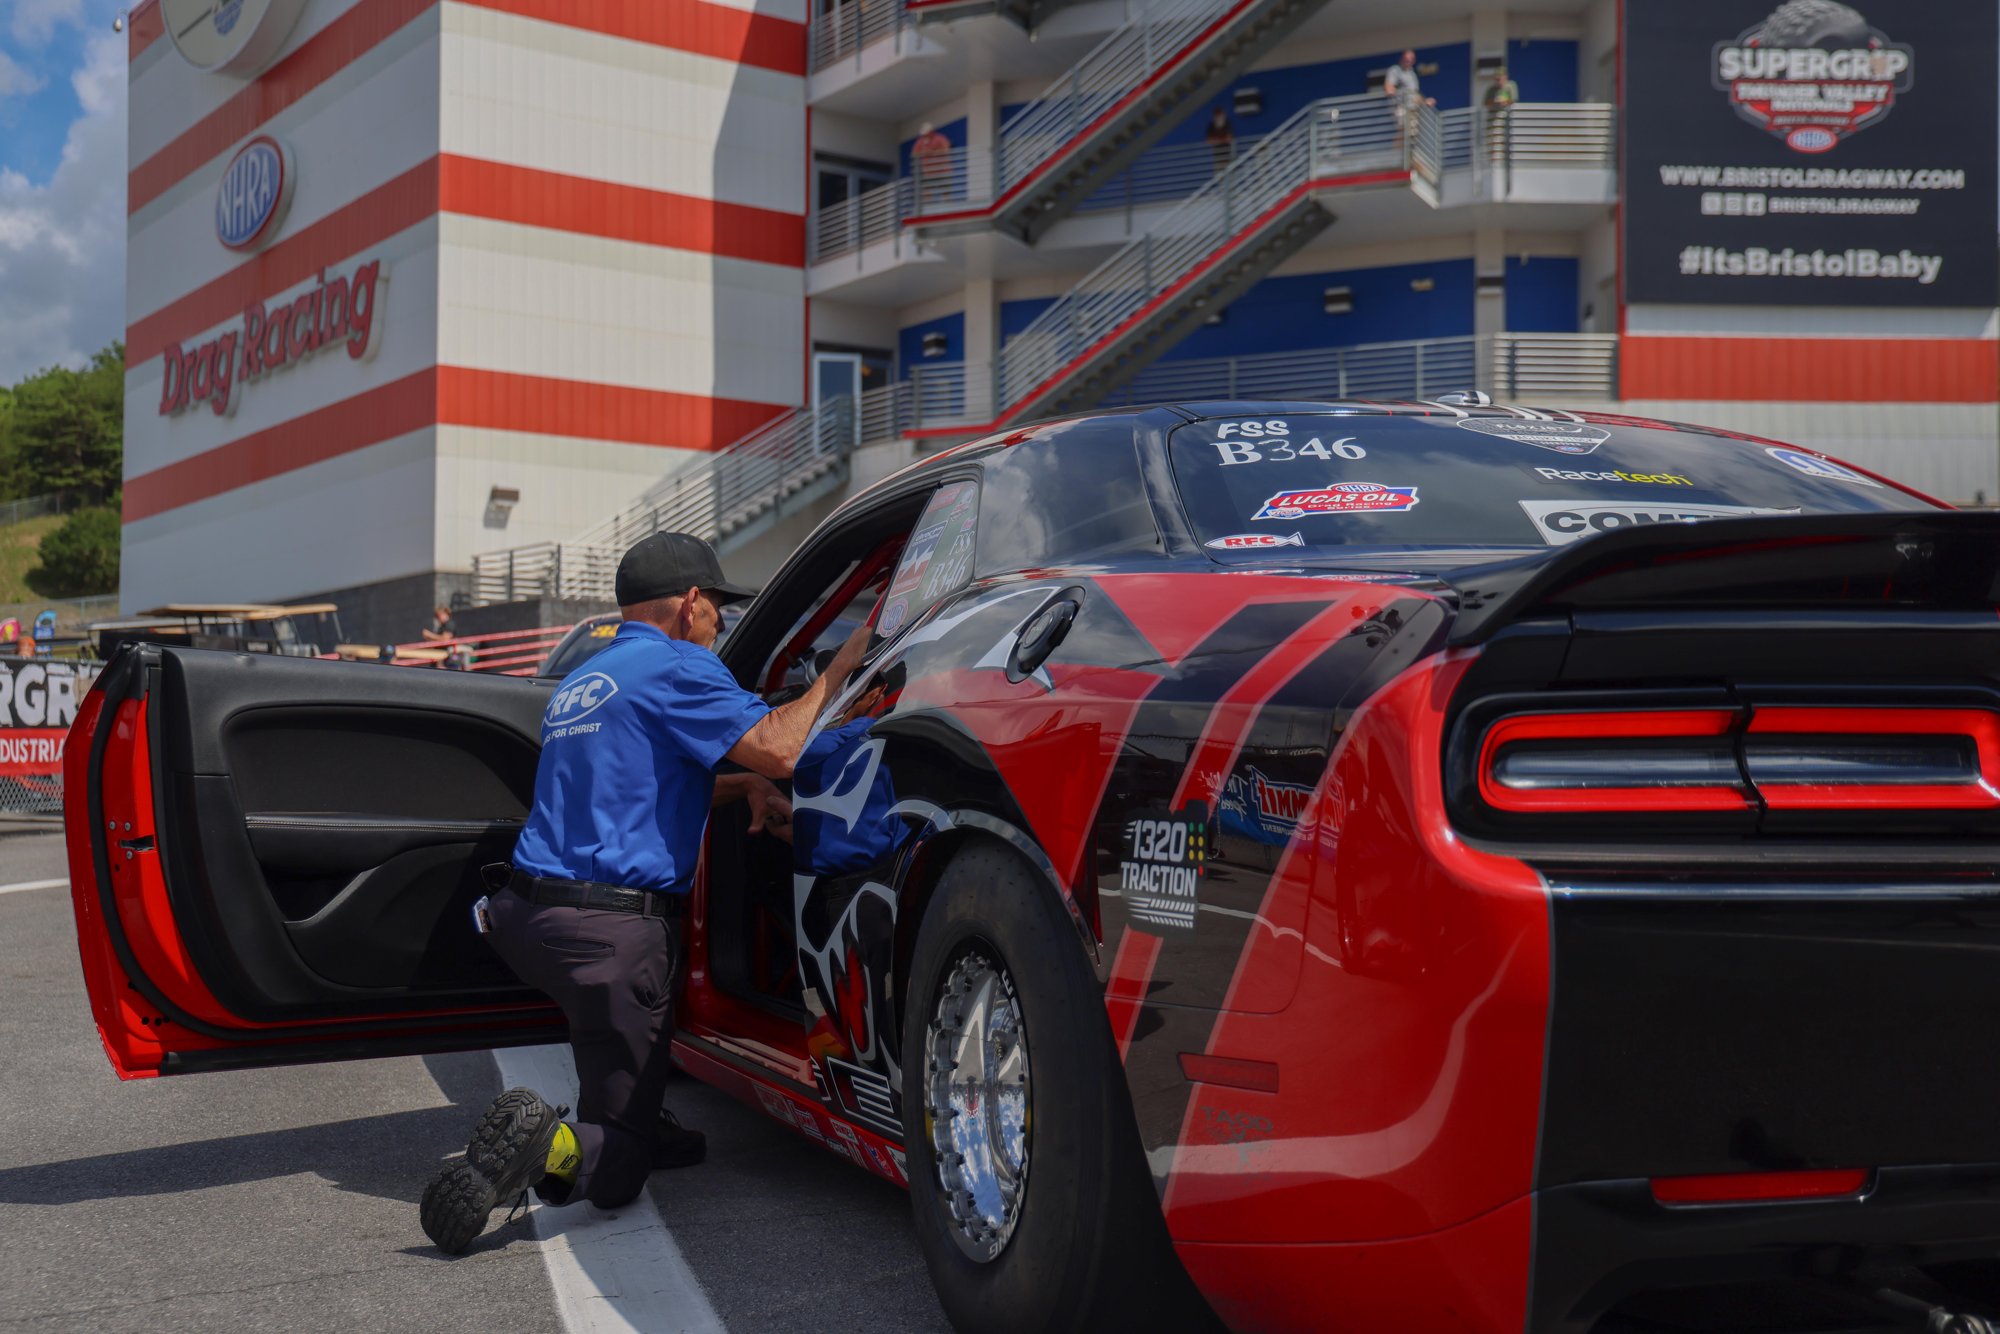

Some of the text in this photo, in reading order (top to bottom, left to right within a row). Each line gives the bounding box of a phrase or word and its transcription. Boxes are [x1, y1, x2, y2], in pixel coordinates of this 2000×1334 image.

[1660, 166, 1965, 189] WWW.BRISTOLDRAGWAY.COM
[219, 152, 271, 236] NHRA
[1768, 198, 1920, 214] BRISTOLDRAGWAY
[1680, 246, 1942, 283] #ItsBristolBaby
[159, 259, 380, 416] Drag Racing
[1217, 420, 1290, 439] FSS
[1210, 437, 1367, 466] B346
[1534, 467, 1694, 486] Racetech
[1278, 493, 1399, 507] LUCAS OIL
[1224, 536, 1276, 546] RFC
[549, 679, 604, 720] RFC
[551, 728, 567, 740] FOR
[568, 723, 602, 736] CHRIST
[1133, 819, 1187, 862] 1320
[1120, 861, 1197, 897] TRACTION
